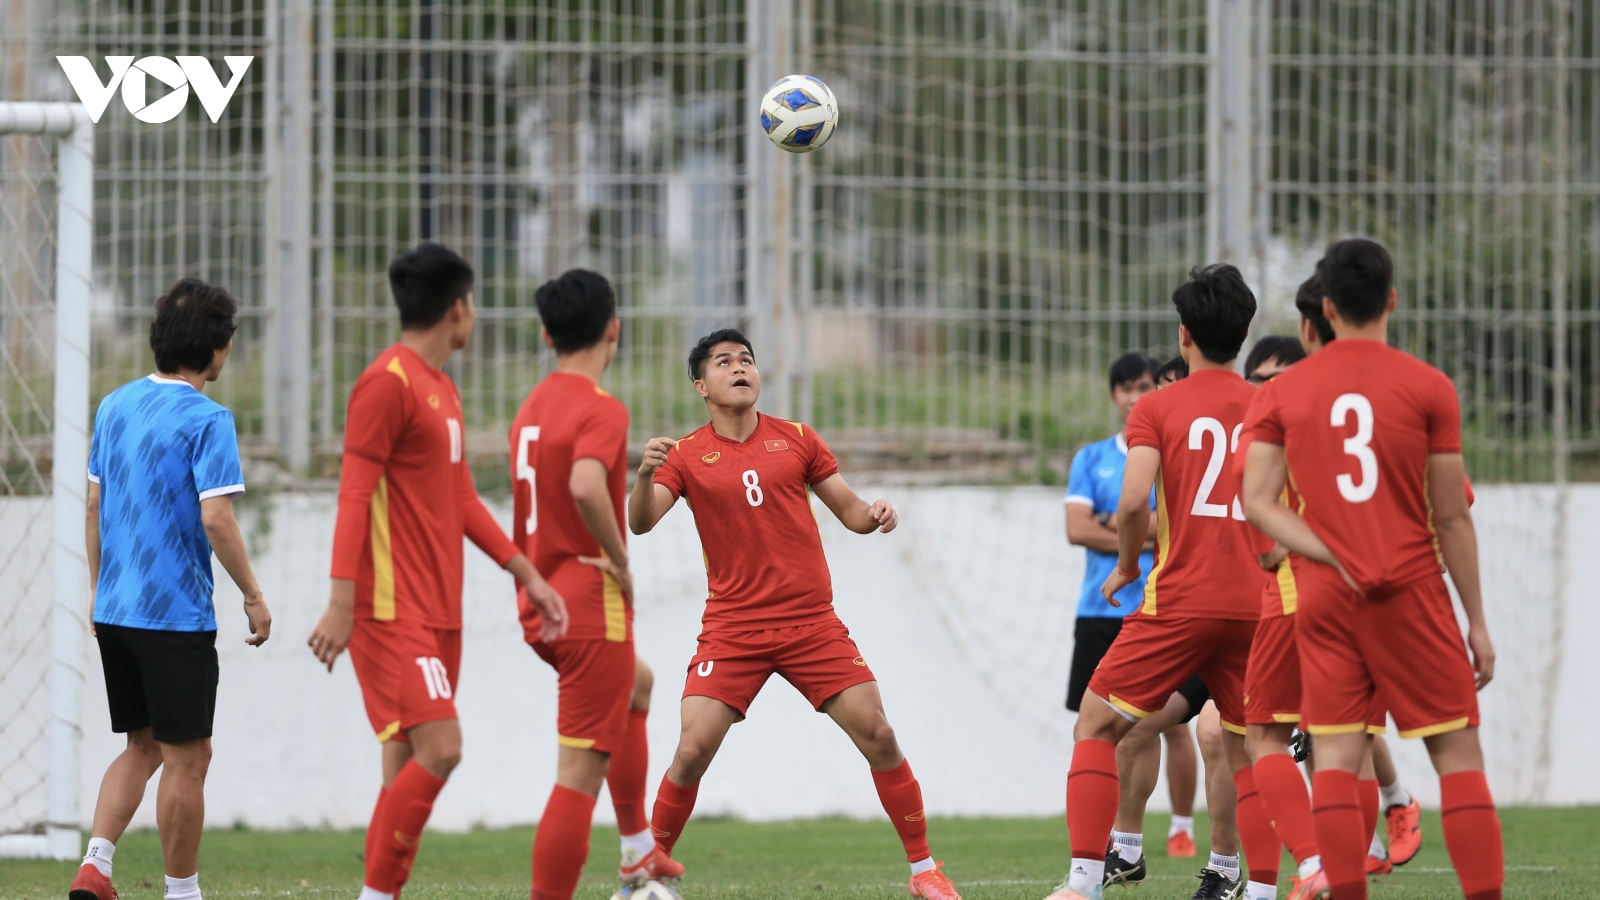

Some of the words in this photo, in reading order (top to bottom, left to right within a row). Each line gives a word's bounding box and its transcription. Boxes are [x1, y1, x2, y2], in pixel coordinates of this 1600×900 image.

[516, 425, 540, 536] 5
[1329, 393, 1378, 503] 3
[741, 469, 764, 507] 8
[415, 656, 452, 700] 10
